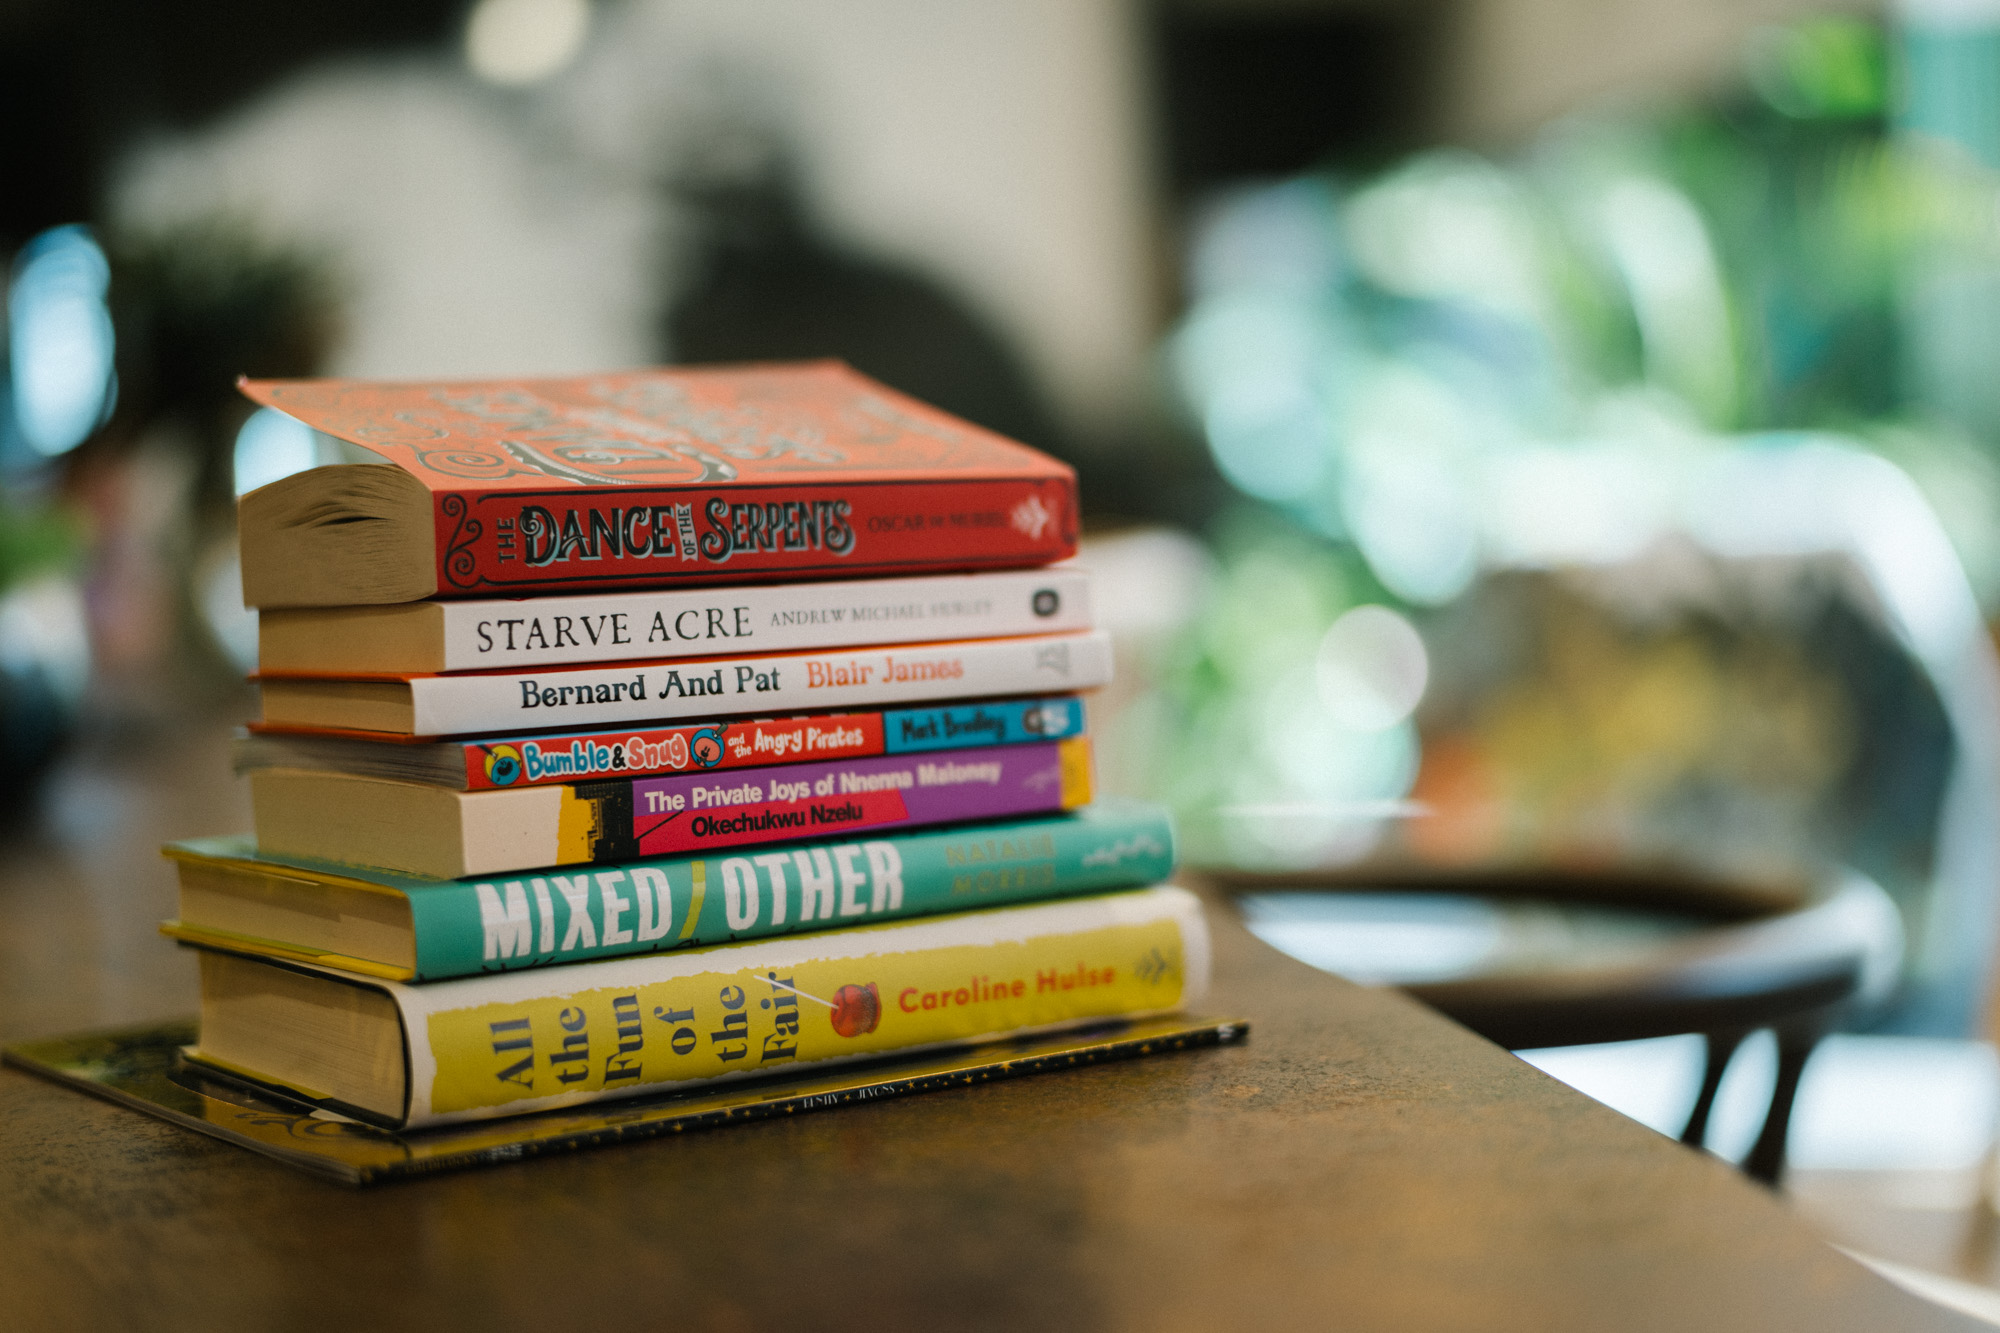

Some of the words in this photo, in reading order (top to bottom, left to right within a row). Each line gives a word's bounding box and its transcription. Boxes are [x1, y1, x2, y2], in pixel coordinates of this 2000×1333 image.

[497, 517, 516, 564] THE
[519, 505, 675, 568] DANCE
[677, 508, 692, 536] THE
[700, 497, 855, 563] SERPENTS
[868, 514, 925, 533] OSCAR
[683, 539, 696, 556] OF
[477, 613, 632, 653] STARVE
[648, 606, 754, 643] ACRE
[771, 608, 847, 626] ANDREW
[852, 604, 925, 622] MICHAEL
[519, 675, 647, 709] Bernard
[659, 670, 724, 699] And
[734, 666, 781, 694] Pat
[805, 660, 874, 689] Blair
[882, 656, 965, 684] James
[522, 740, 610, 781] Bumble
[625, 733, 688, 768] Snug
[728, 732, 745, 747] and
[734, 745, 752, 758] the
[754, 727, 803, 756] Angry
[807, 725, 865, 751] Pirates
[645, 790, 686, 813] The
[692, 782, 763, 808] Private
[768, 778, 811, 803] Joys
[815, 774, 836, 796] of
[839, 770, 914, 794] Nnenna
[692, 810, 806, 837] Okechukwu
[810, 802, 863, 825] Nzelu
[475, 867, 673, 961] MIXED
[720, 841, 904, 931] OTHER
[899, 975, 1025, 1013] Caroline
[1036, 961, 1117, 994] Hulse
[603, 992, 645, 1086] Fun
[654, 1005, 697, 1056] of
[709, 985, 748, 1064] the
[760, 971, 800, 1064] Fair
[489, 1015, 534, 1090] All
[550, 1005, 590, 1086] the
